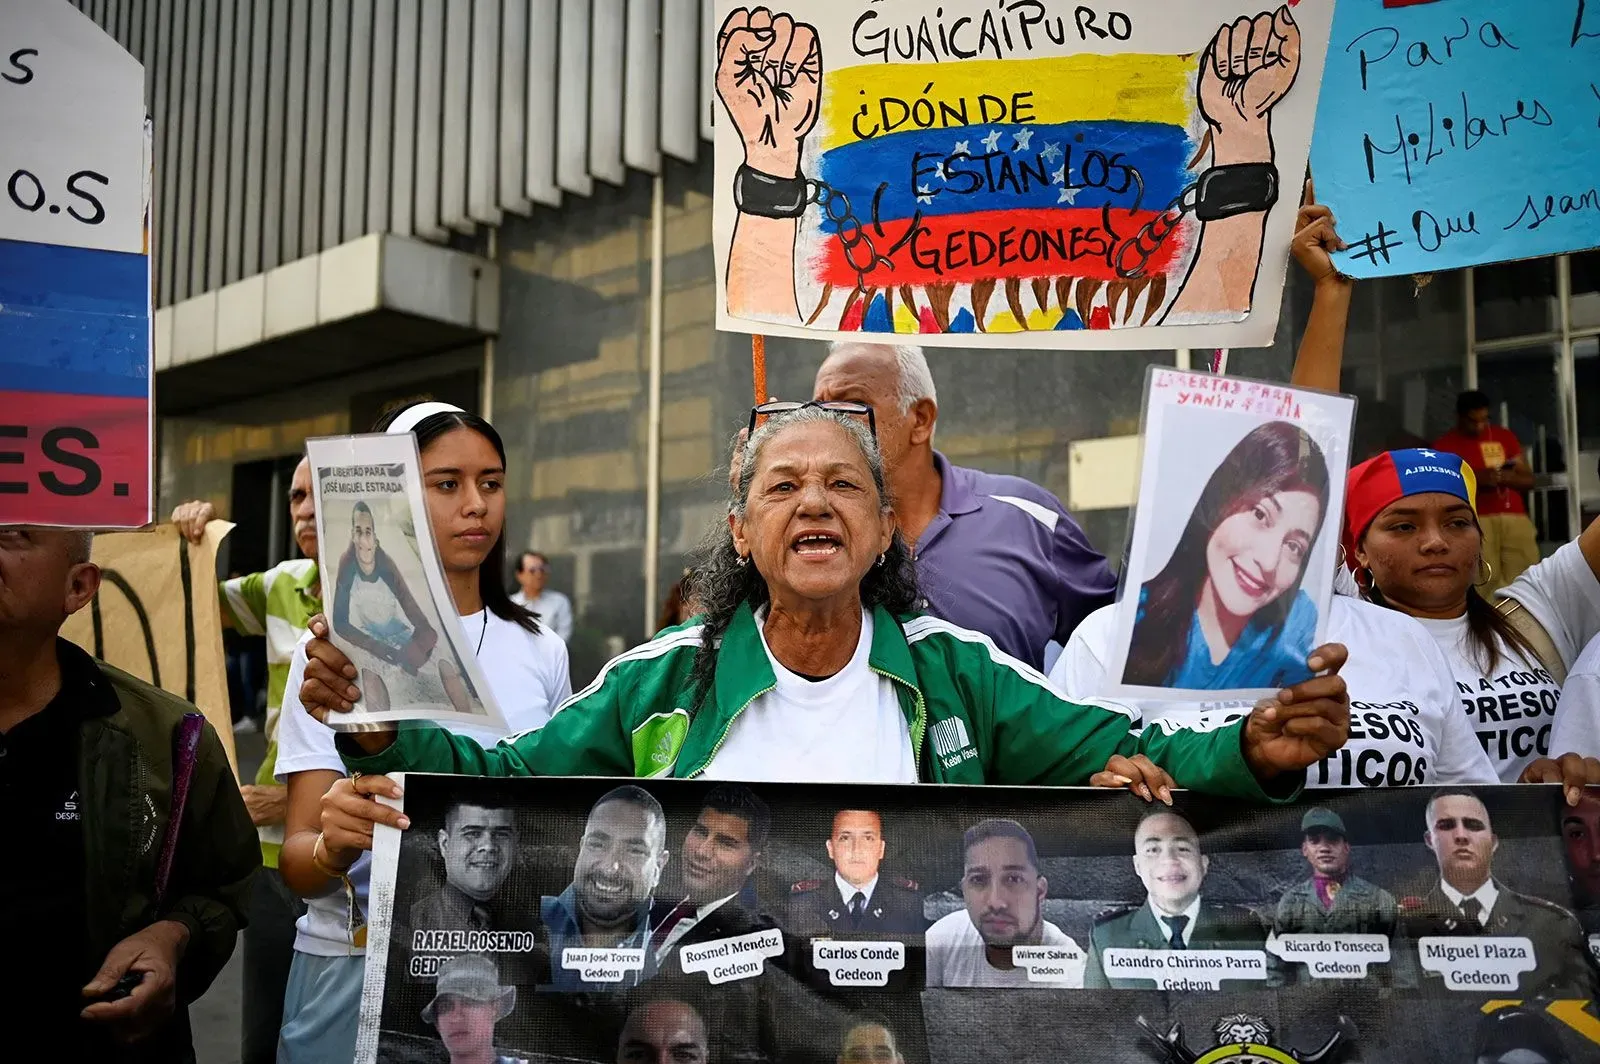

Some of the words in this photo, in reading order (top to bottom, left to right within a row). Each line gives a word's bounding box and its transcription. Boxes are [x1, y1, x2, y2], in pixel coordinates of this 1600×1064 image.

[1346, 17, 1520, 91] Para
[852, 82, 1035, 139] ¿DÓNDE
[1064, 143, 1131, 193] LOS
[332, 465, 363, 478] LIBERTAD
[364, 466, 387, 478] PARA
[338, 481, 365, 494] MIGUEL
[366, 481, 404, 494] ESTRADA
[1478, 677, 1495, 691] A
[1350, 700, 1420, 715] ODOS
[412, 930, 468, 952] RAFAEL
[468, 930, 535, 953] ROSENDO
[1284, 940, 1332, 953] Ricardo
[685, 944, 729, 963] Rosmel
[731, 935, 779, 955] Mendez
[818, 946, 858, 960] Carlos
[860, 946, 900, 960] Conde
[1015, 950, 1046, 960] Wilmer
[1047, 950, 1078, 960] Salinas
[1426, 944, 1481, 961] Miguel
[1484, 944, 1527, 959] Plaza
[565, 952, 587, 964] Juan
[590, 952, 609, 964] José
[611, 952, 641, 963] Torres
[1109, 954, 1164, 969] Leandro
[1167, 955, 1223, 969] Chirinos
[1226, 956, 1262, 969] Parra
[410, 956, 455, 977] GED
[585, 967, 620, 979] Gedeon
[713, 961, 758, 979] Gedeon
[1031, 965, 1064, 976] Gedeon
[1314, 961, 1362, 974] Gedeon
[835, 968, 883, 981] Gedeon
[1451, 969, 1511, 985] Gedeon
[1162, 978, 1213, 991] Gedeon
